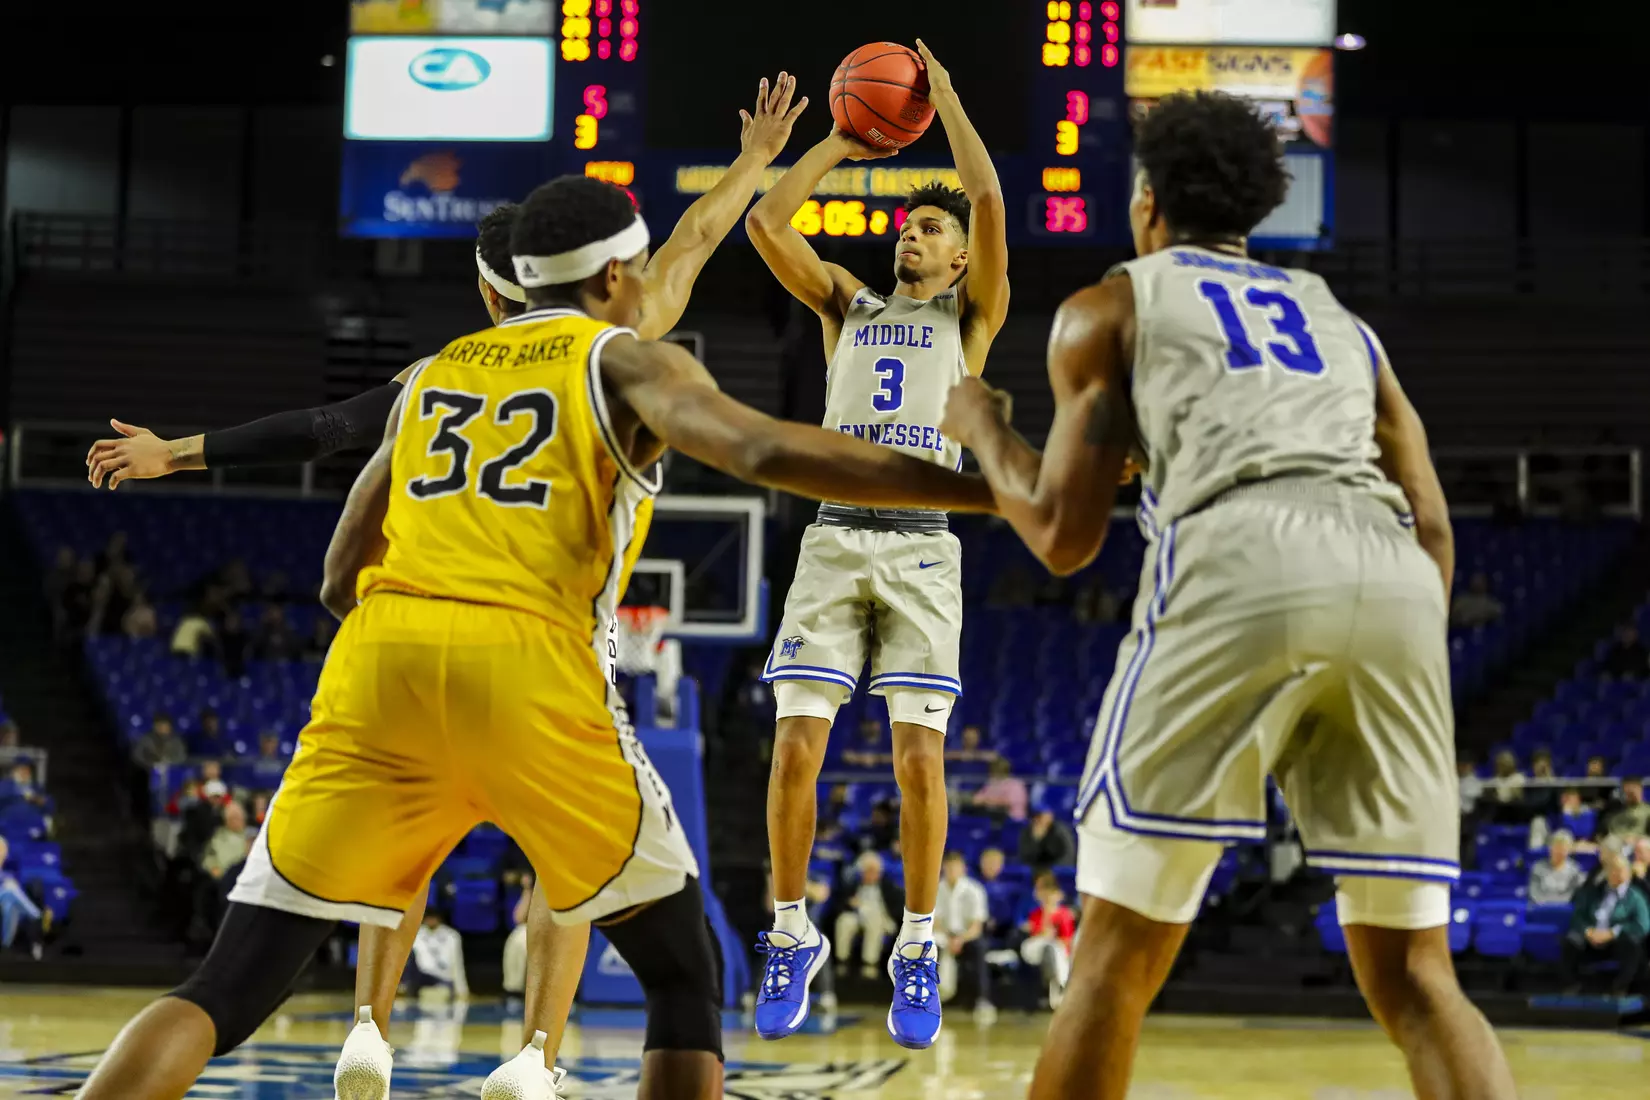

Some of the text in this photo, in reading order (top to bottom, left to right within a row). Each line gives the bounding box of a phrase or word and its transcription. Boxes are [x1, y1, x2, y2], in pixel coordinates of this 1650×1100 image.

[853, 323, 935, 349] MIDDLE
[1194, 278, 1329, 381] 13
[870, 356, 906, 413] 3
[406, 386, 560, 511] 32
[838, 423, 943, 452] ENNESSEE
